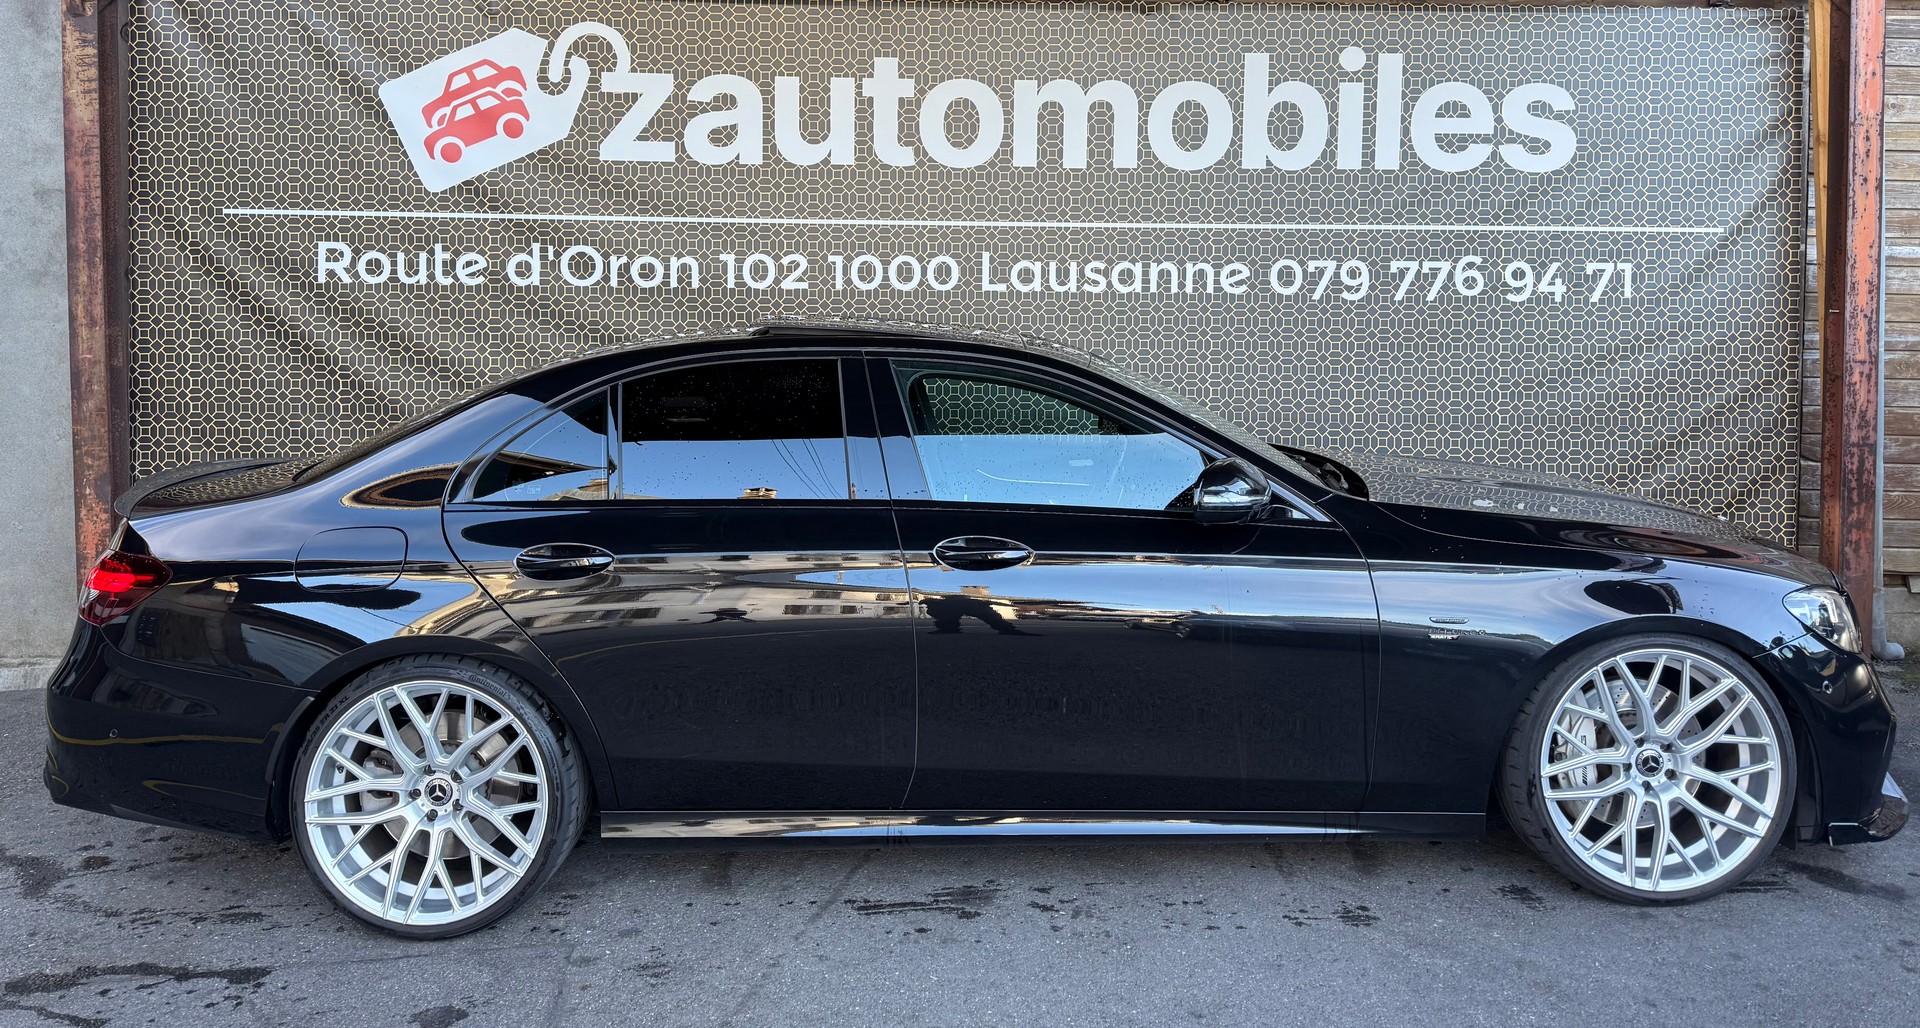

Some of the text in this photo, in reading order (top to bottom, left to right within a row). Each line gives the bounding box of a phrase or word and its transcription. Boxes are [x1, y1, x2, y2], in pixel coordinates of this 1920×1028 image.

[598, 47, 1579, 175] zautomobiles
[318, 241, 1635, 304] Route d'Oron 102 1000 Lausanne 079 776 94 71
[468, 674, 508, 697] Continental
